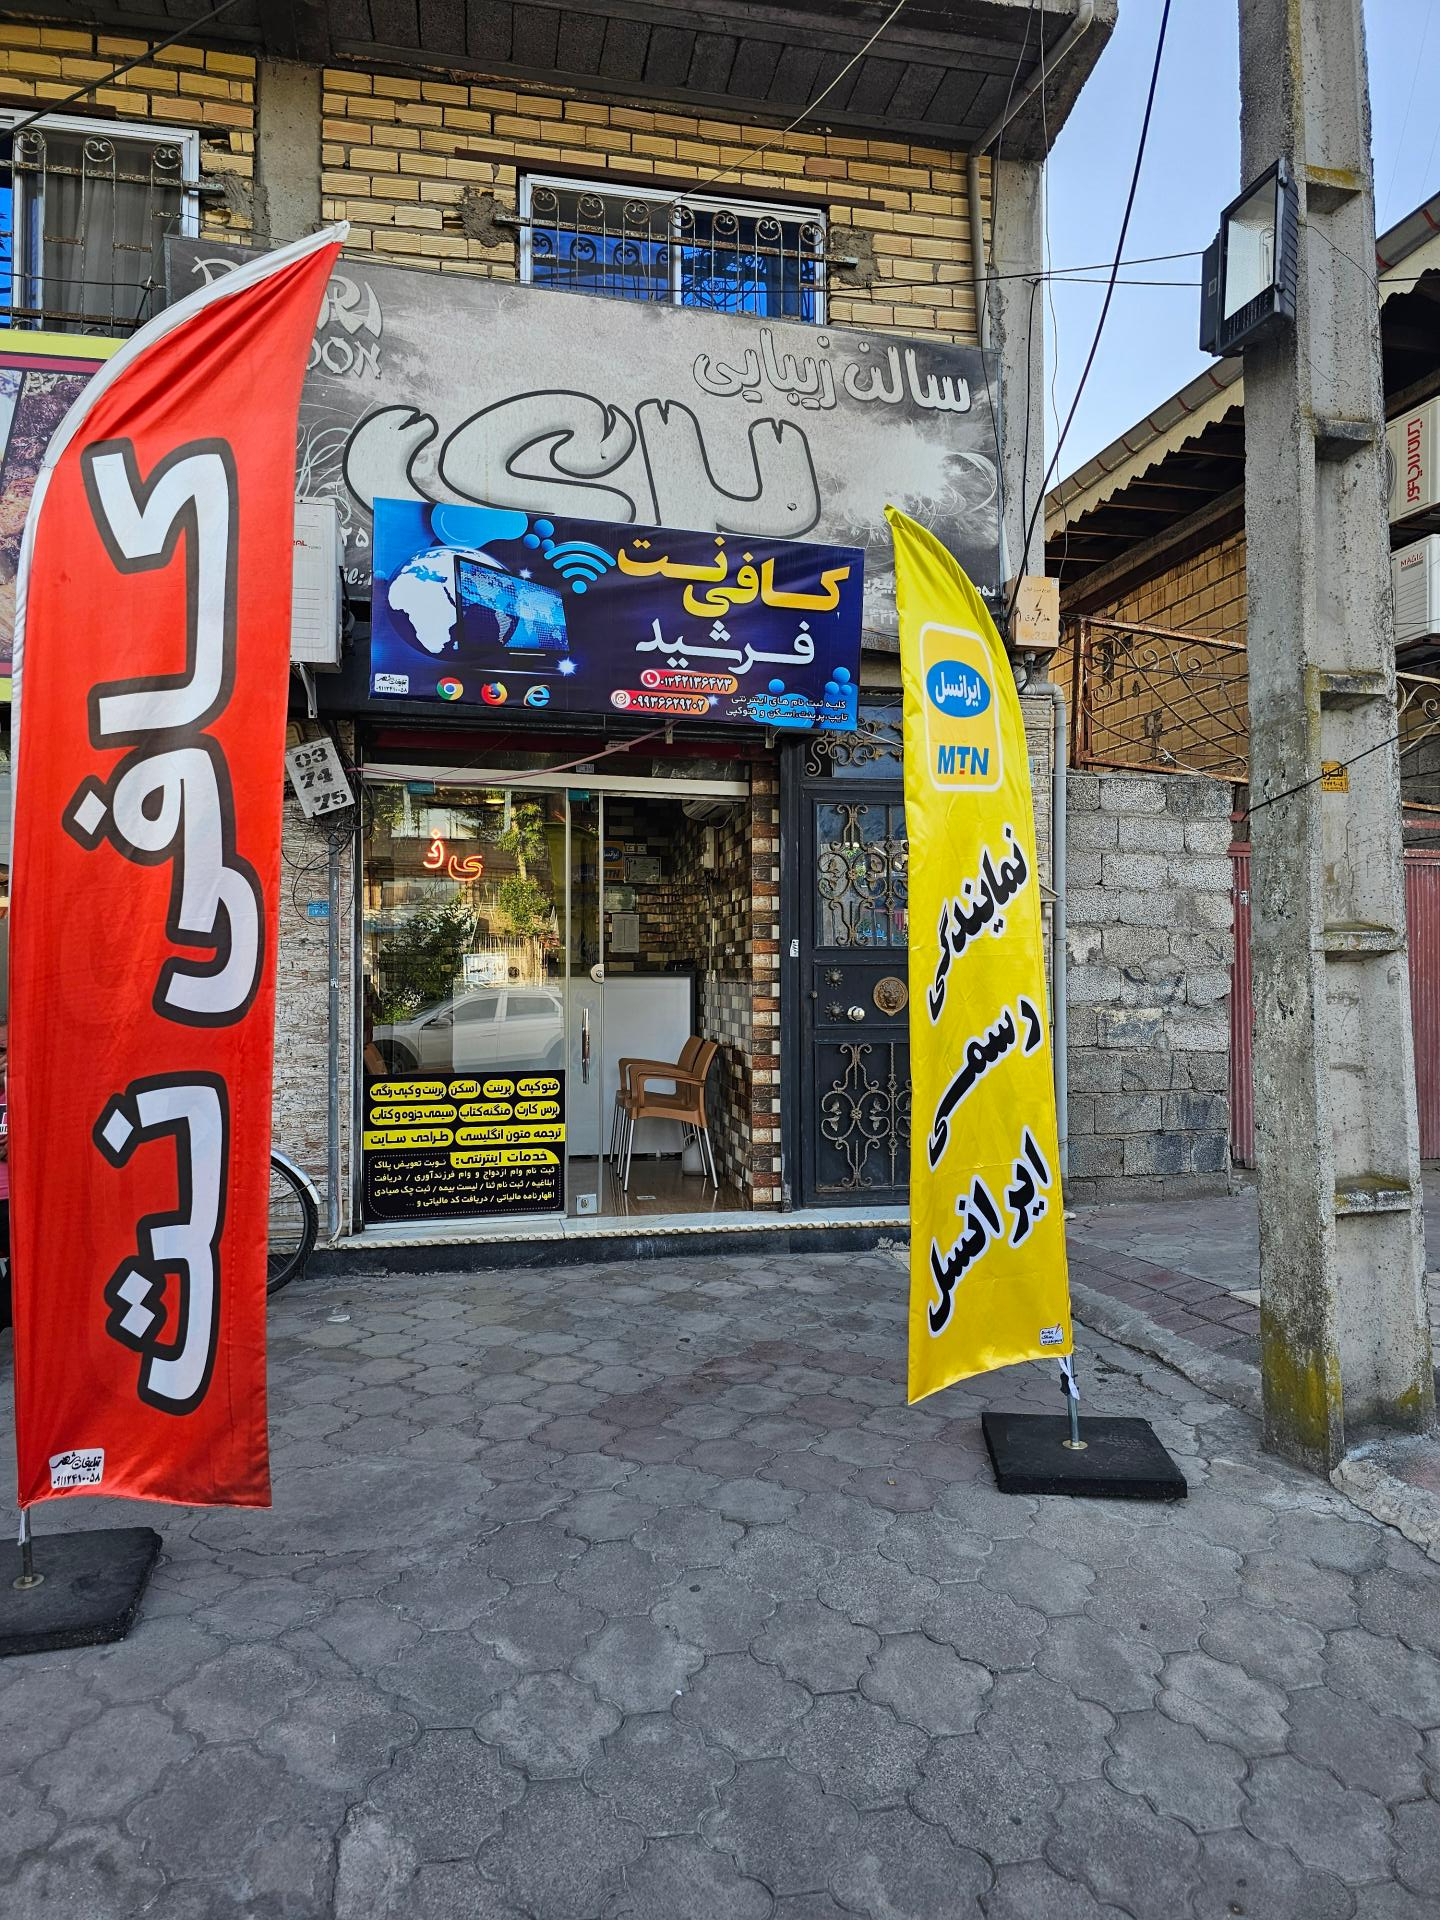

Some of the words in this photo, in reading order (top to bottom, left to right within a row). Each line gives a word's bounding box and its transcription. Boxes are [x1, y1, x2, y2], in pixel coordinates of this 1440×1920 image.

[692, 328, 837, 410] زیبایی
[844, 341, 972, 413] سالن
[617, 535, 728, 584] نت
[1401, 552, 1424, 567] MAGIC
[683, 551, 851, 617] کافی
[636, 618, 816, 675] فرشید
[932, 665, 983, 708] ایرانسل
[731, 696, 767, 704] اینترنتی
[769, 697, 788, 706] های
[807, 699, 824, 707] ثبت
[826, 701, 846, 710] کلیه
[726, 707, 757, 717] فتوکپی
[760, 710, 765, 718] و
[58, 436, 267, 1028] کافی
[936, 746, 989, 777] MTN
[927, 825, 1029, 1026] نمایندگی
[519, 1081, 559, 1094] فتوکپی
[927, 996, 1040, 1170] رسمی
[371, 1085, 392, 1098] رنگی
[394, 1085, 414, 1098] کپی
[415, 1089, 420, 1097] و
[423, 1086, 444, 1098] پرینت
[451, 1083, 478, 1096] اسکن
[487, 1084, 511, 1095] پرینت
[402, 1110, 422, 1120] جزوه
[424, 1109, 454, 1118] سیمی
[460, 1107, 486, 1118] کتاب
[485, 1105, 510, 1116] منگنه
[517, 1104, 537, 1115] کارت
[540, 1106, 558, 1117] پرس
[372, 1110, 393, 1121] کتاب
[395, 1112, 400, 1122] و
[371, 1133, 406, 1145] سایت
[412, 1131, 449, 1143] طراحی
[460, 1129, 503, 1142] انگلیسی
[507, 1129, 530, 1140] متون
[534, 1128, 561, 1139] ترجمه
[456, 1152, 502, 1166] اینترنتی:
[508, 1151, 547, 1163] خدمات
[375, 1160, 391, 1169] پلاک
[540, 1166, 555, 1174] ثبت
[375, 1174, 402, 1183] دریافت
[483, 1170, 507, 1180] ازدواج
[511, 1169, 522, 1177] وام
[401, 1186, 413, 1196] چک
[416, 1185, 431, 1193] ثبت
[439, 1184, 457, 1192] بیمه
[458, 1183, 478, 1191] لیست
[486, 1181, 496, 1190] ثنا
[497, 1182, 508, 1190] نام
[375, 1188, 399, 1197] صیادی
[423, 1197, 448, 1206] مالیاتی
[462, 1195, 488, 1203] دریافت
[497, 1194, 521, 1203] مالیاتی
[927, 1125, 1050, 1343] ایرانسل
[92, 1072, 234, 1417] نت
[51, 1452, 80, 1468] شهر
[72, 1456, 102, 1471] تبلیغات
